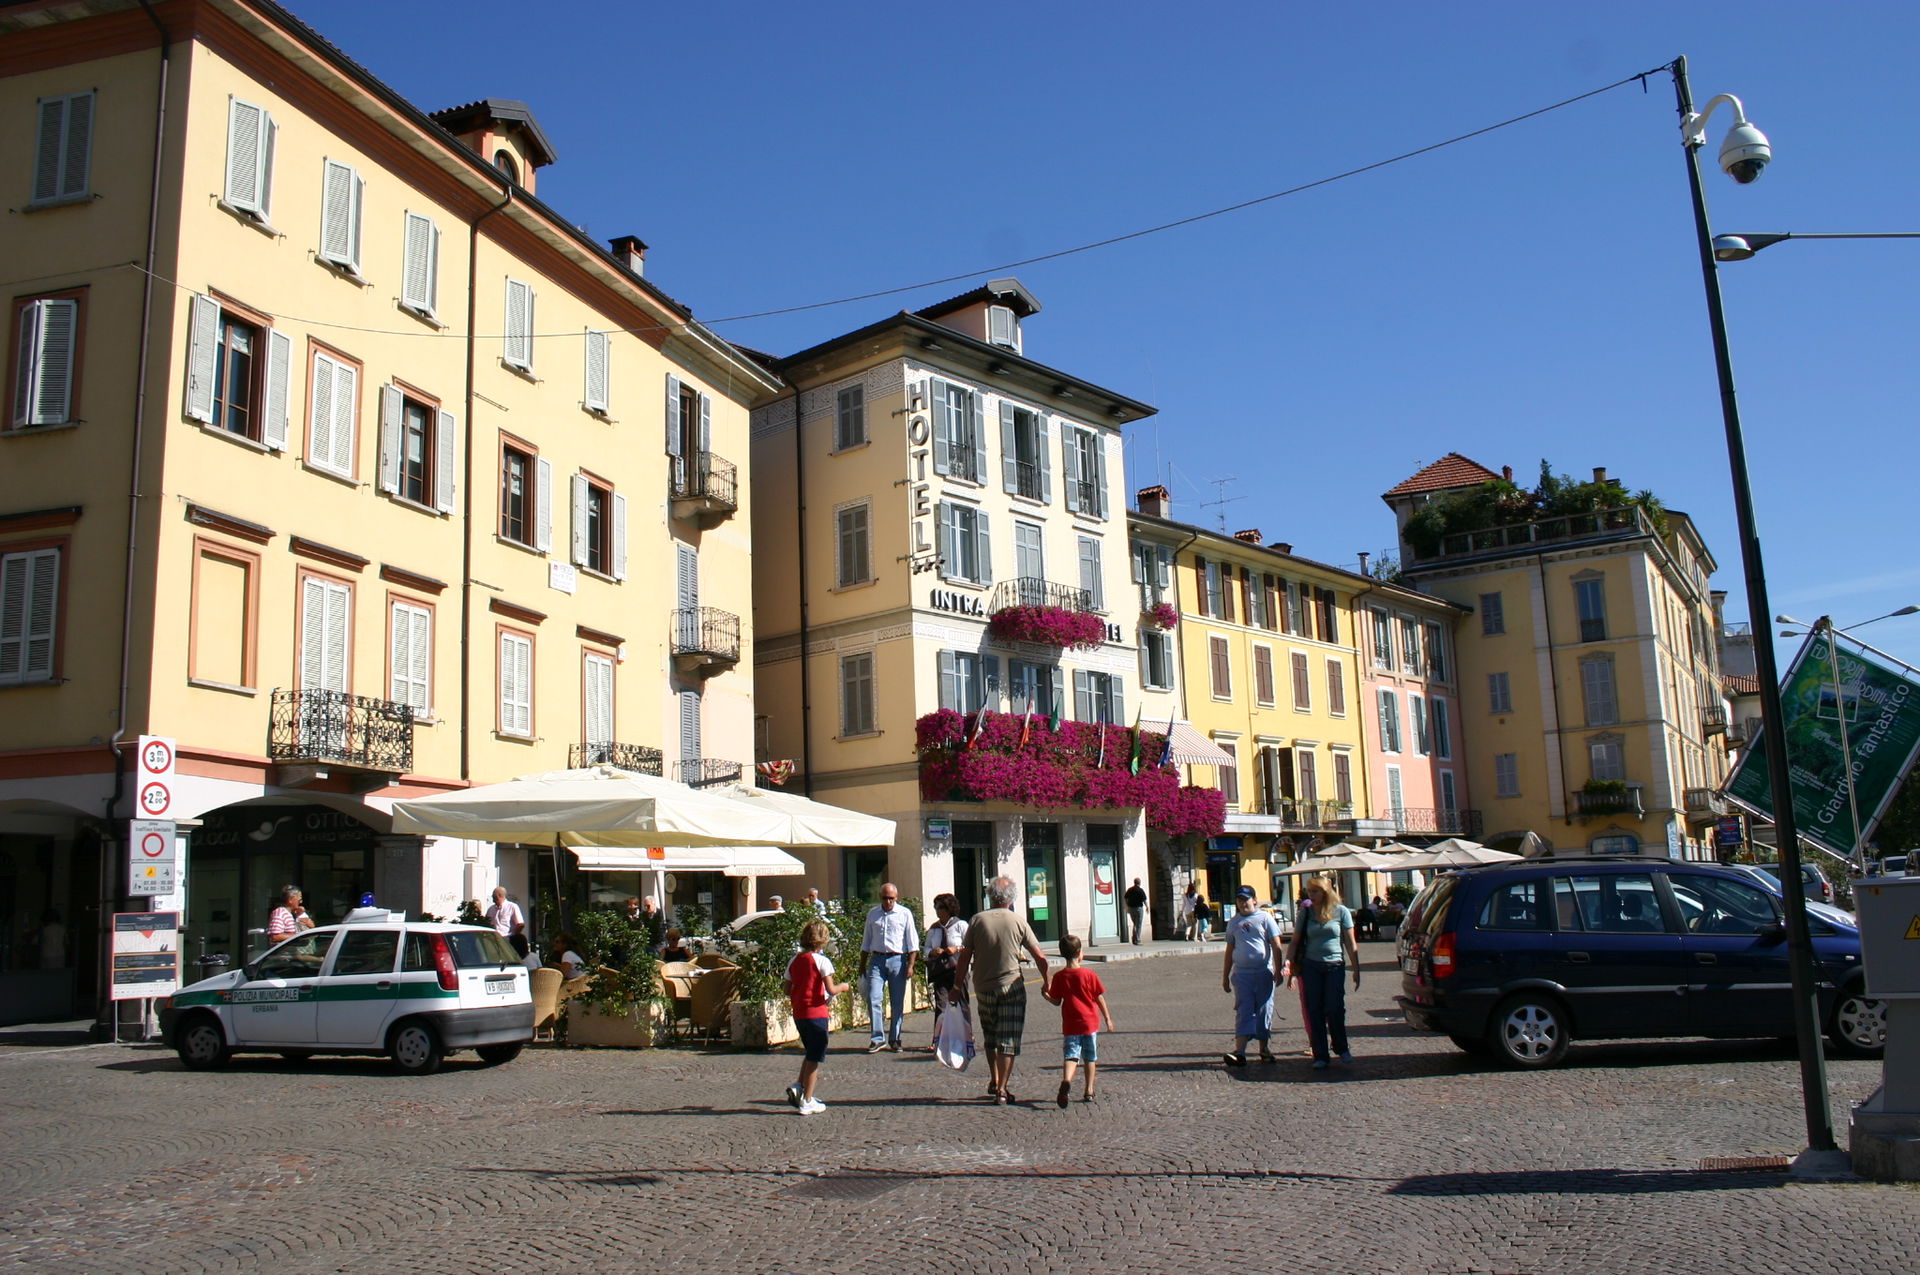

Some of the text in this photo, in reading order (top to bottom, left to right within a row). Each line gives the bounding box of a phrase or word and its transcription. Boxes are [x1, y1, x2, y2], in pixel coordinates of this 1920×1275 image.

[909, 380, 932, 552] HOTEL
[931, 588, 987, 616] INTRA
[1856, 684, 1910, 759] fantastico
[149, 751, 155, 762] 3
[148, 792, 154, 804] 2
[233, 989, 298, 1001] POLIZIA MUNICIPALE
[252, 1005, 279, 1013] VERBANIA
